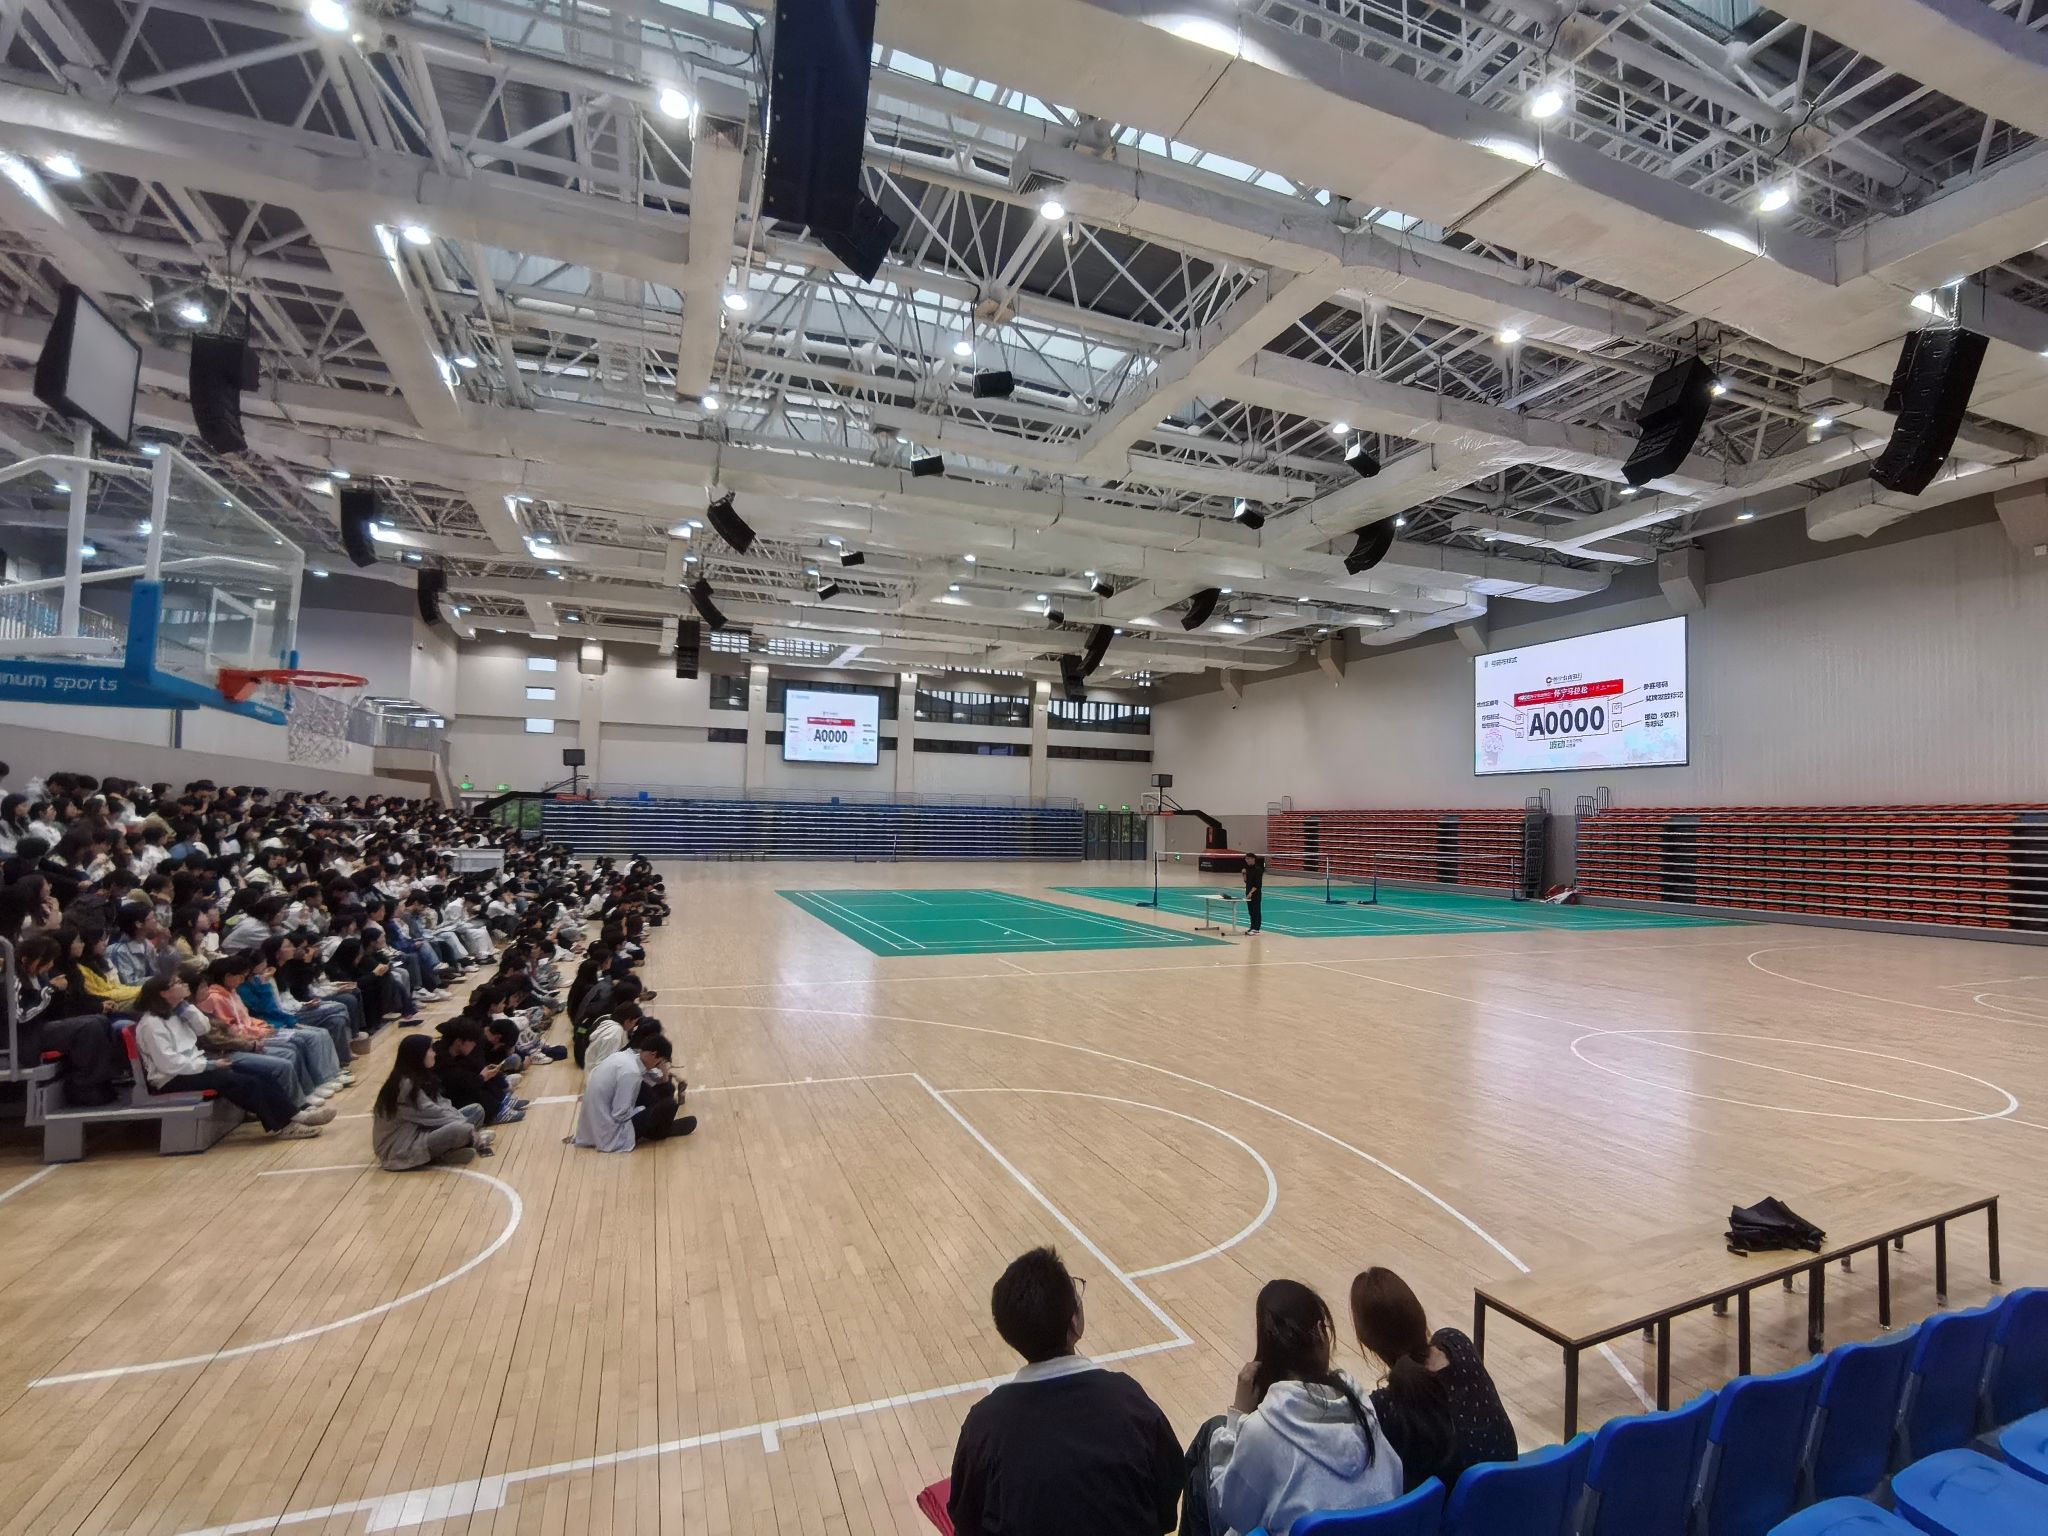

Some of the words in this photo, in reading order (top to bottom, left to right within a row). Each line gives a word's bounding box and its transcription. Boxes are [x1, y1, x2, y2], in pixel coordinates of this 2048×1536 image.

[54, 676, 118, 692] sports
[1529, 706, 1604, 736] A0000
[814, 729, 848, 743] A0000
